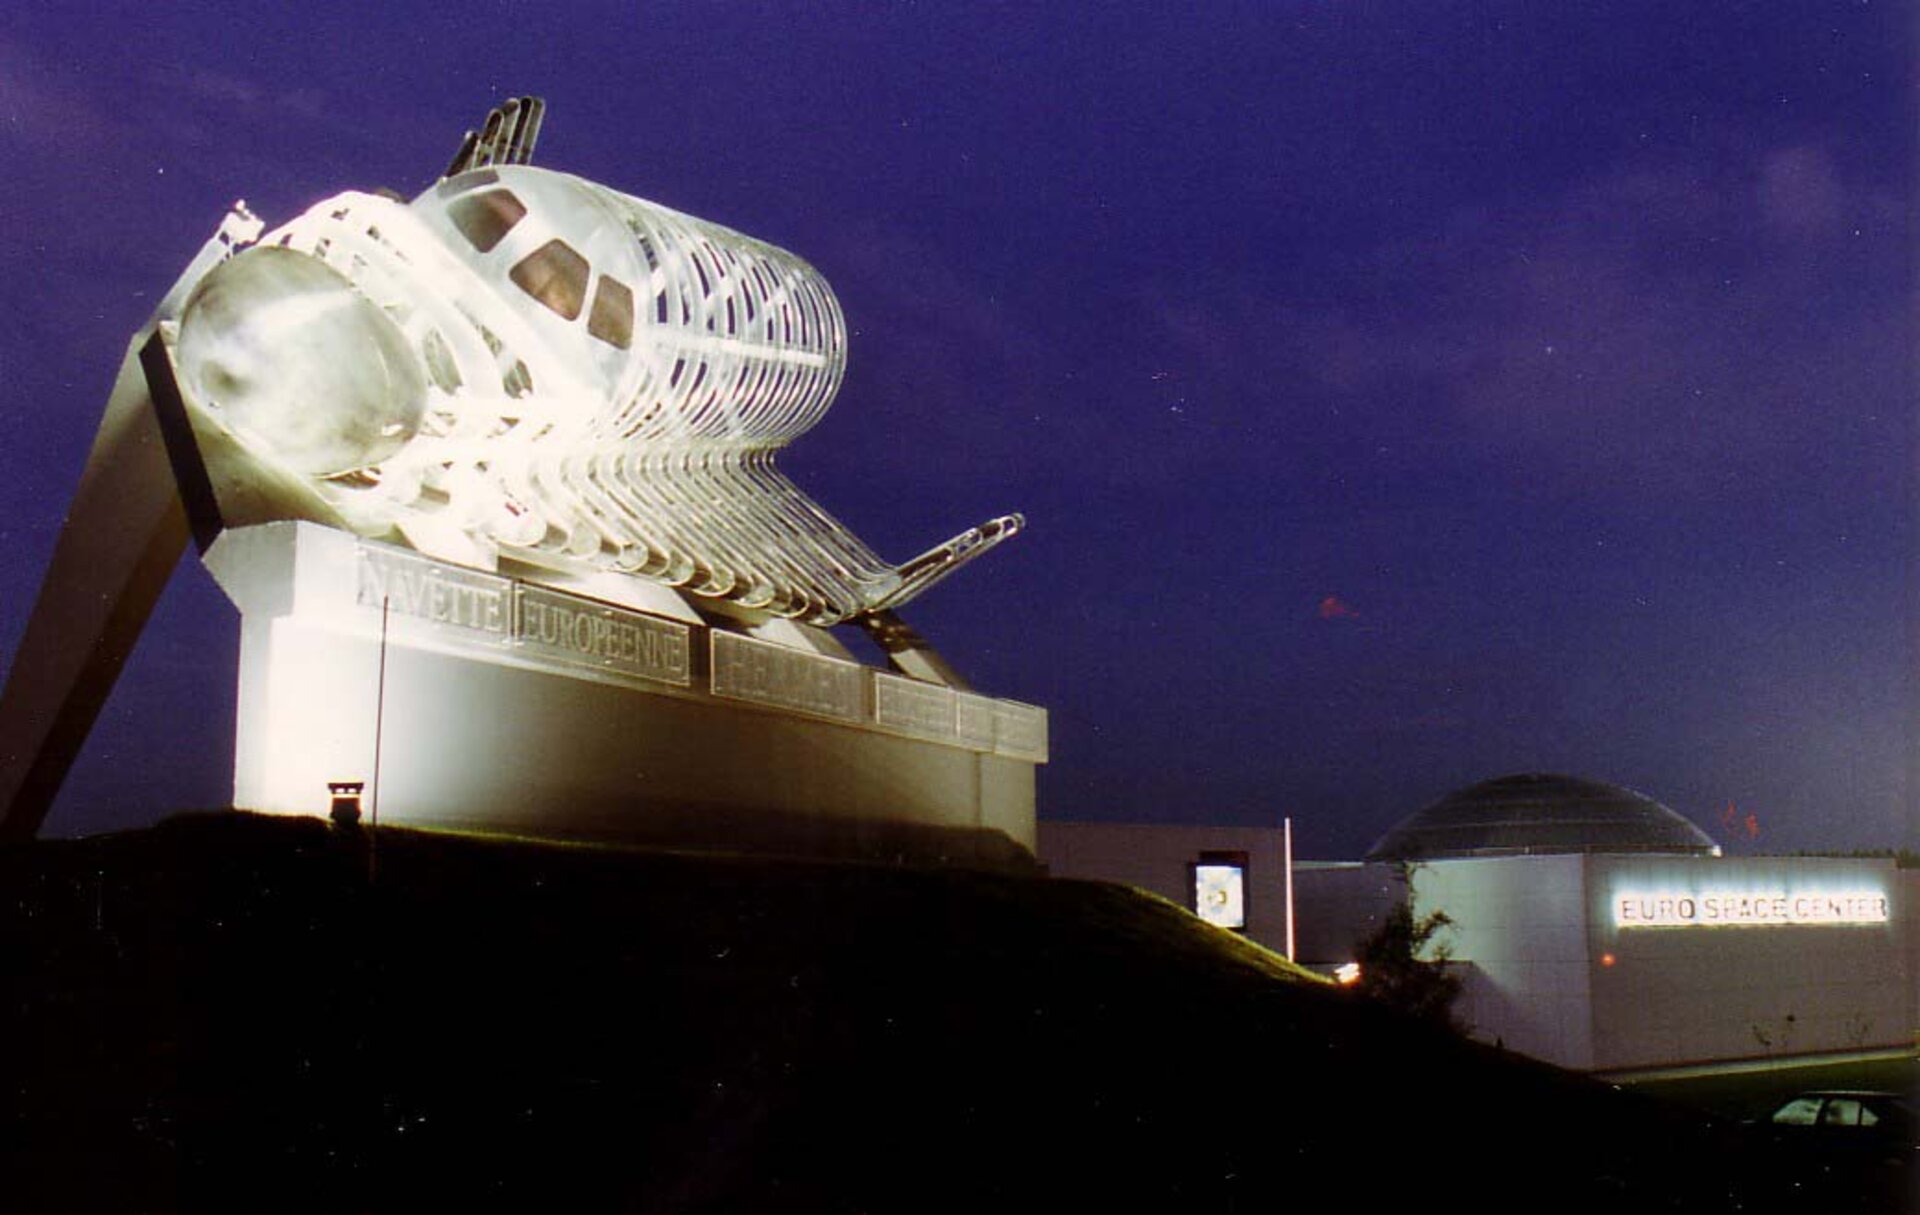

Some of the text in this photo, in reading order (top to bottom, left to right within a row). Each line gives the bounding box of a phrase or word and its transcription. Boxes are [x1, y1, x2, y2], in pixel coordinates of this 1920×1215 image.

[356, 556, 502, 632] NAVETTE
[1621, 897, 1888, 920] EURO SPACE CENTER
